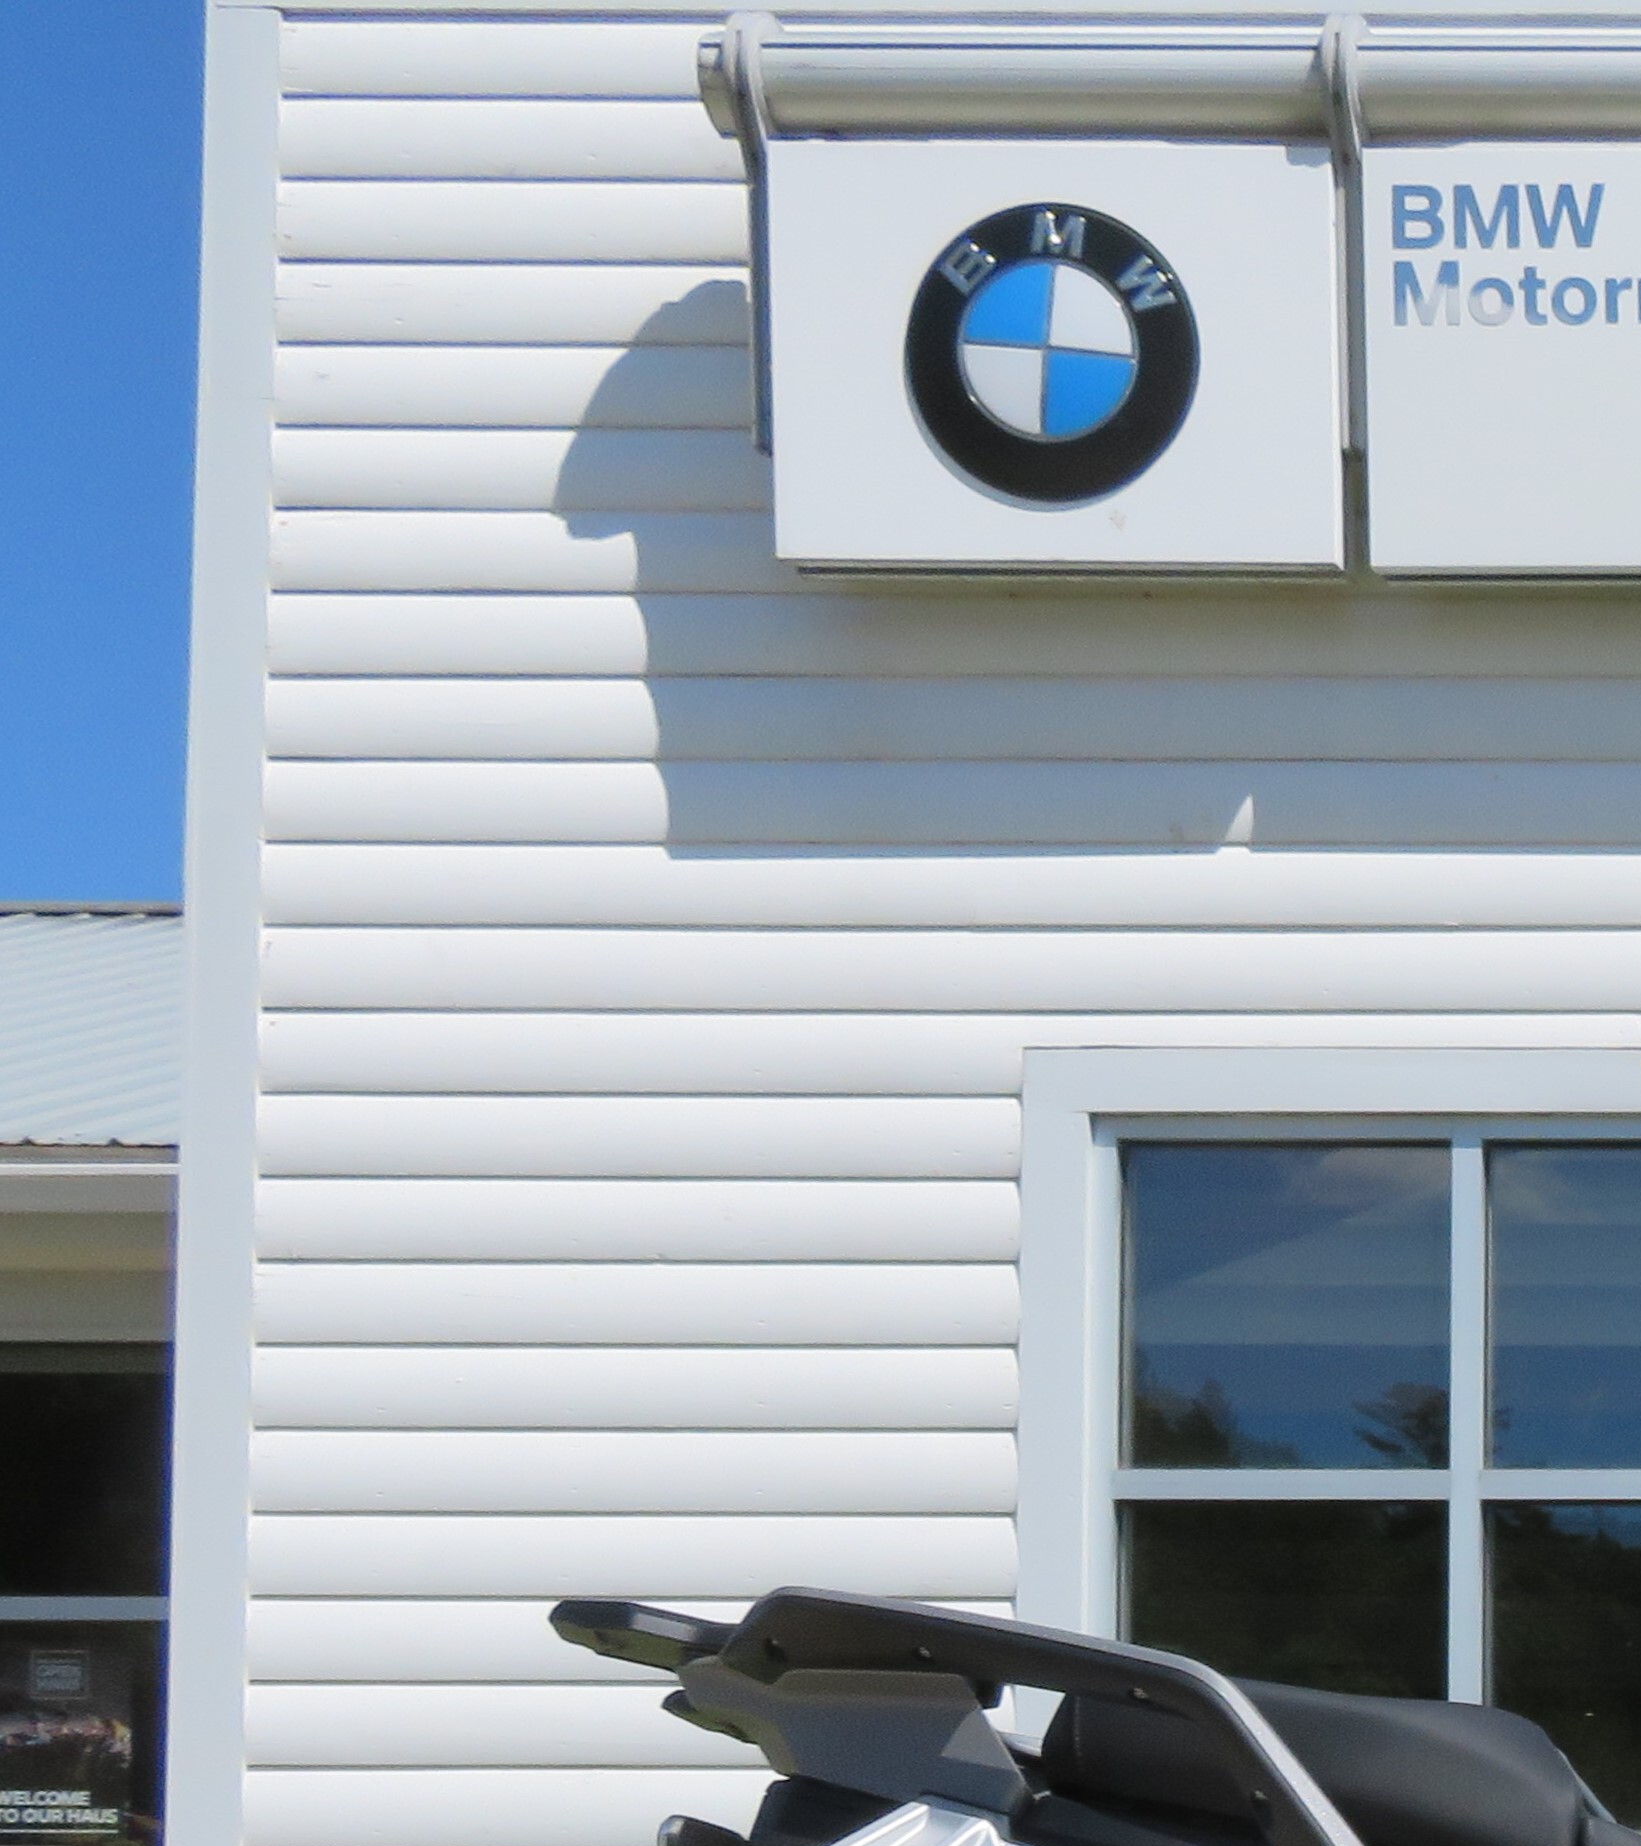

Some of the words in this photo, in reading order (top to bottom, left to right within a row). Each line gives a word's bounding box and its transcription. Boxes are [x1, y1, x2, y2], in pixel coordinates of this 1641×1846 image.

[1391, 183, 1605, 250] BMW
[938, 206, 1178, 312] BMW
[0, 1791, 91, 1807] WELCOME
[21, 1808, 63, 1824] OUR
[66, 1808, 118, 1824] HAUS
